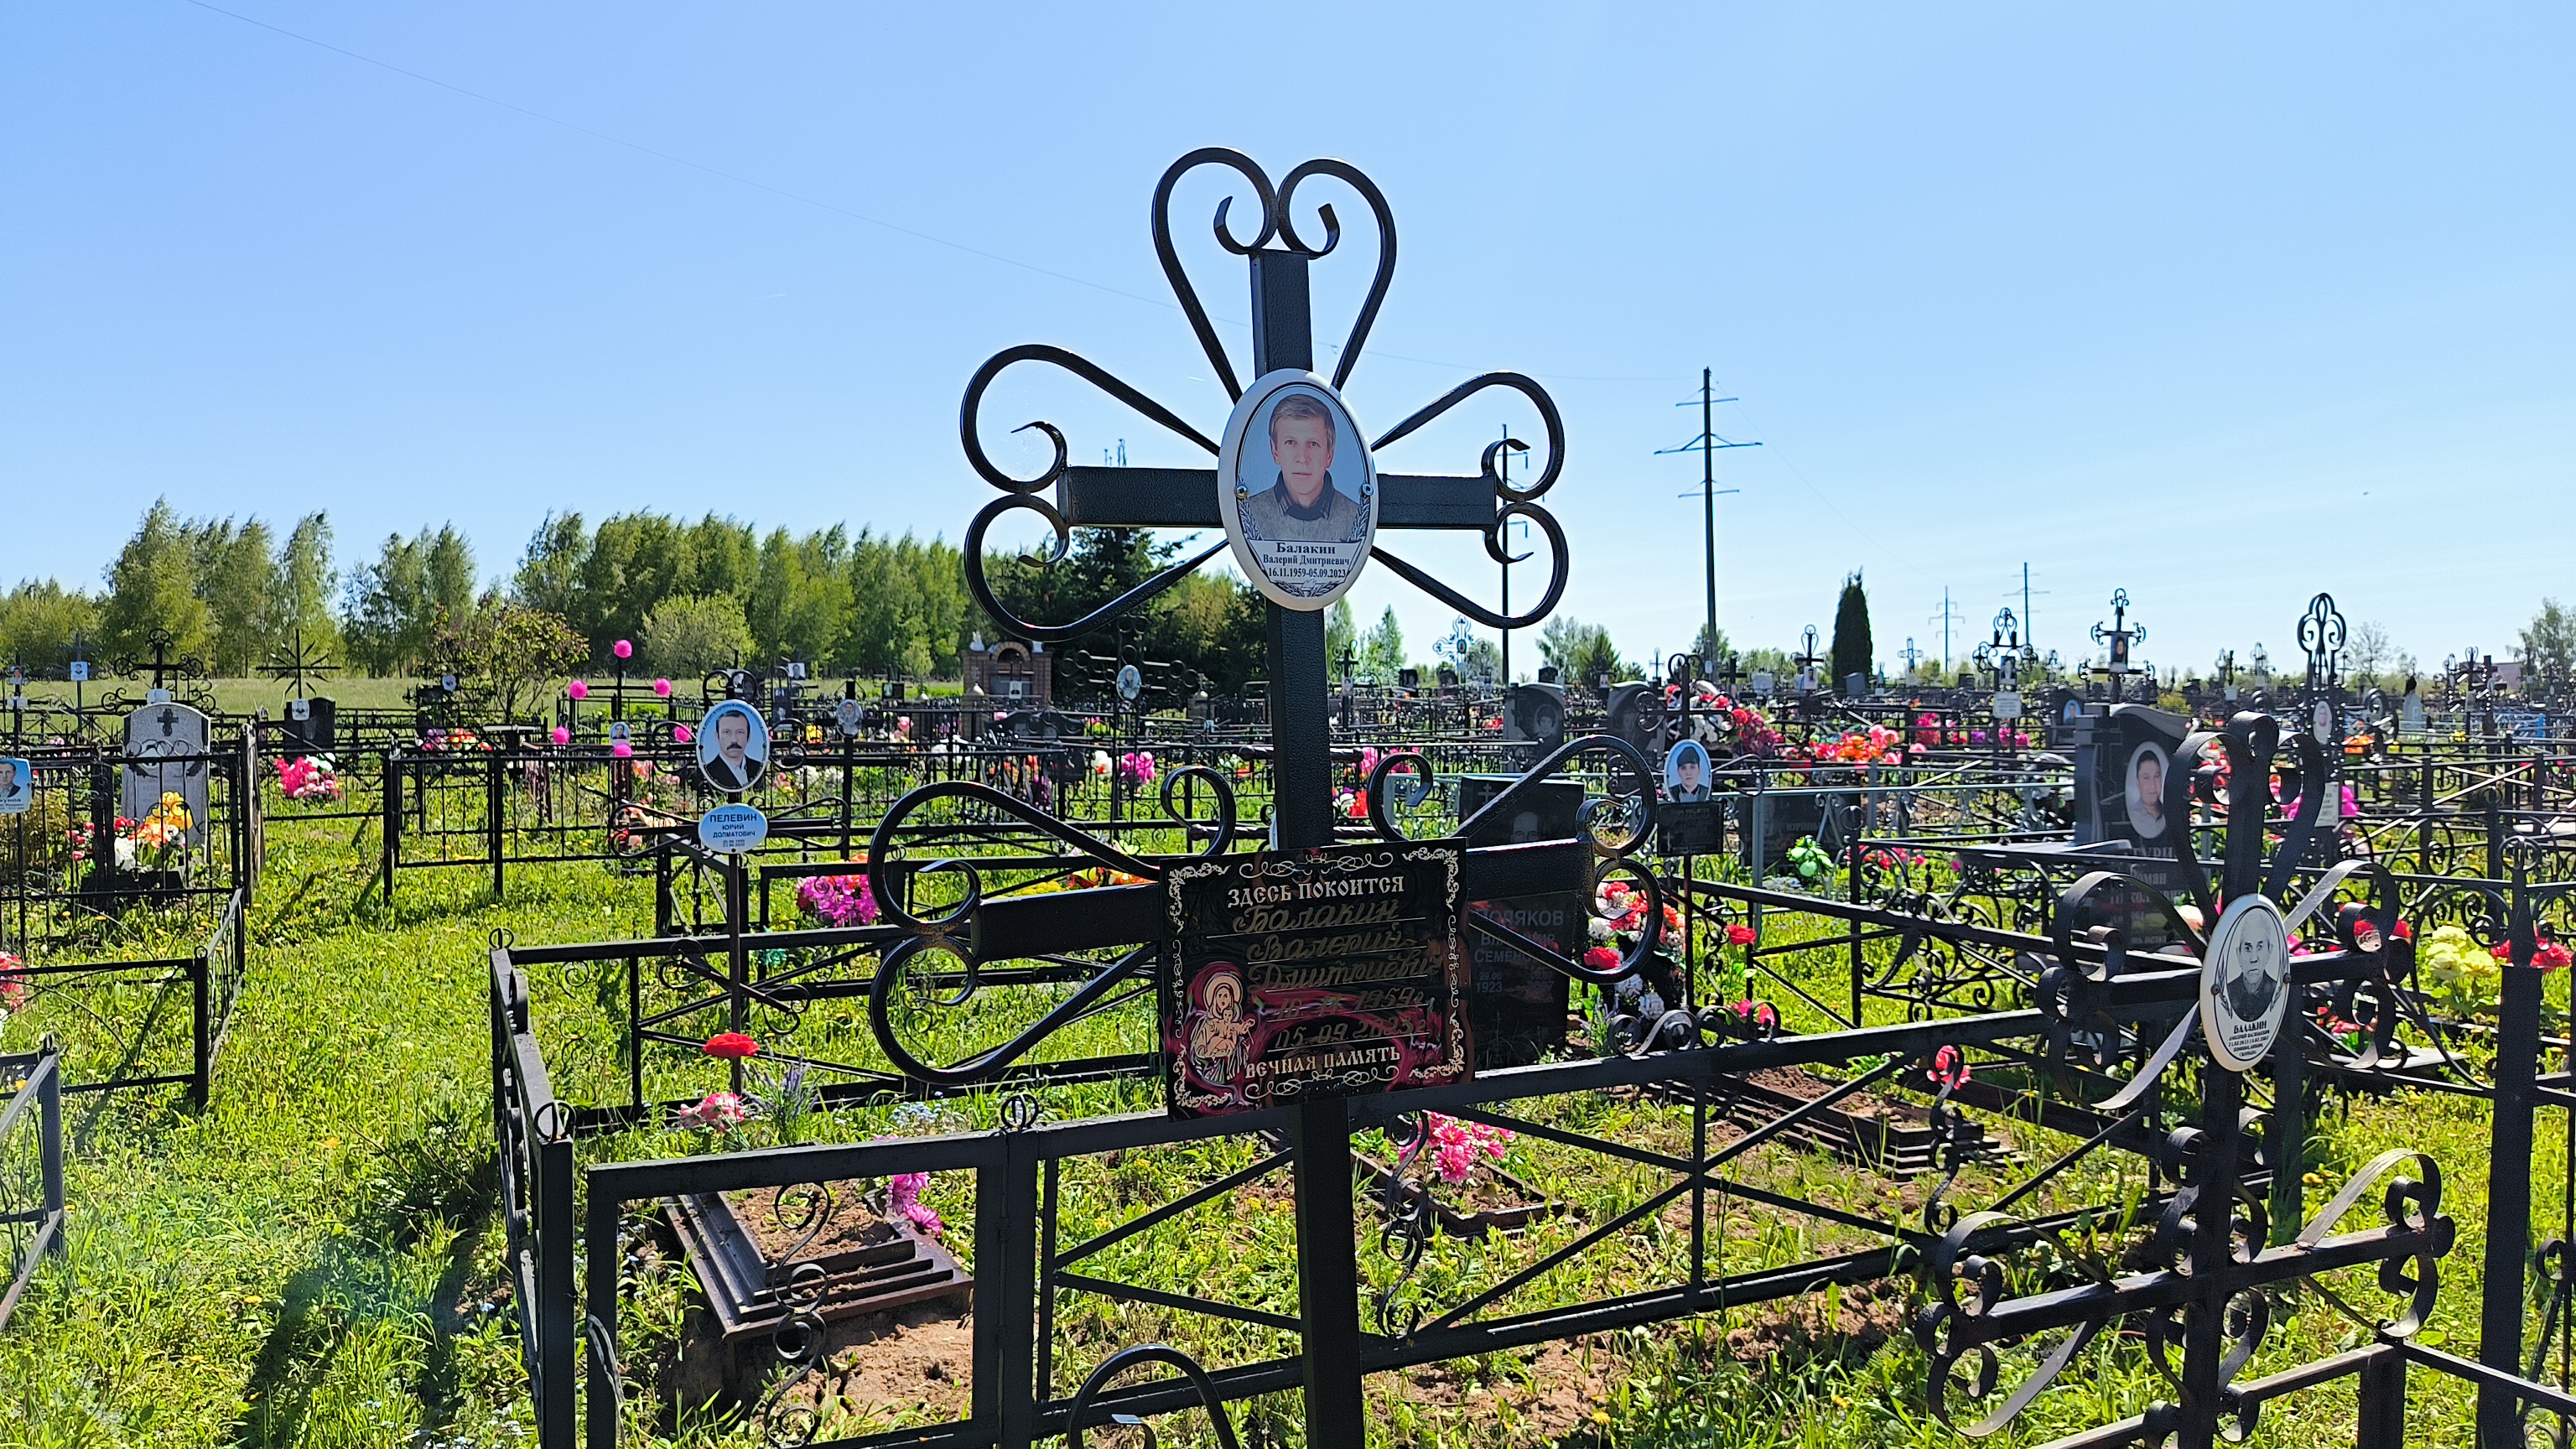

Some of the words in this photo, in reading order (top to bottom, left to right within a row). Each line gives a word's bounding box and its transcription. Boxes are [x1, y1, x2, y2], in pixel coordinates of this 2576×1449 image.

[1276, 543, 1336, 553] Балакин
[1263, 553, 1298, 566] Валерий
[1300, 554, 1349, 567] Дмитриевич
[1268, 567, 1346, 578] 16.11.1959-05.09.2023
[710, 813, 756, 822] ПЕЛЕВИН
[1228, 885, 1291, 908] ЗДЕСЬ
[1298, 875, 1405, 900] ПОКОИТСЯ
[1233, 898, 1400, 933] Балакин
[1246, 922, 1409, 962] Валерий
[1476, 981, 1503, 993] 1923
[2234, 1021, 2267, 1034] БАЛАКИН
[1244, 1055, 1317, 1078] ВЕЧНАЯ
[1323, 1046, 1400, 1068] ПАМЯТЬ
